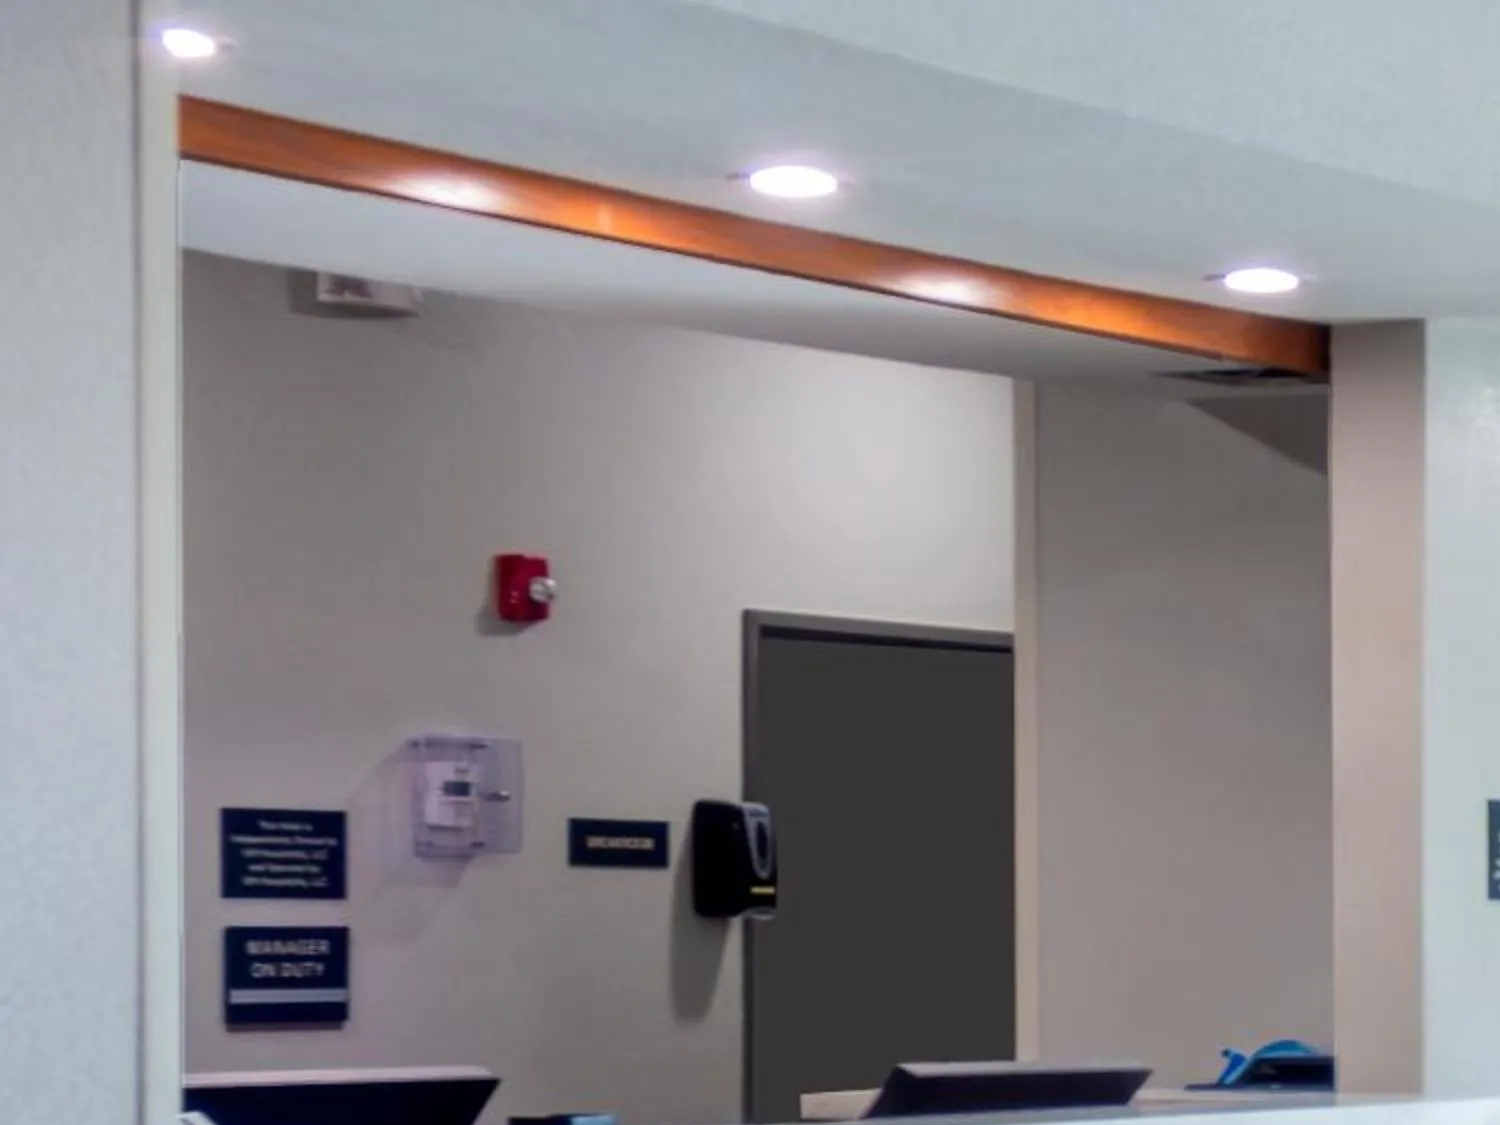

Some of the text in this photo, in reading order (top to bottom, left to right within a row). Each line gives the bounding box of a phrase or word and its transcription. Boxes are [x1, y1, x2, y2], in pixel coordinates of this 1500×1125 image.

[245, 939, 331, 956] MANAGER
[249, 962, 325, 978] ON DUTY
